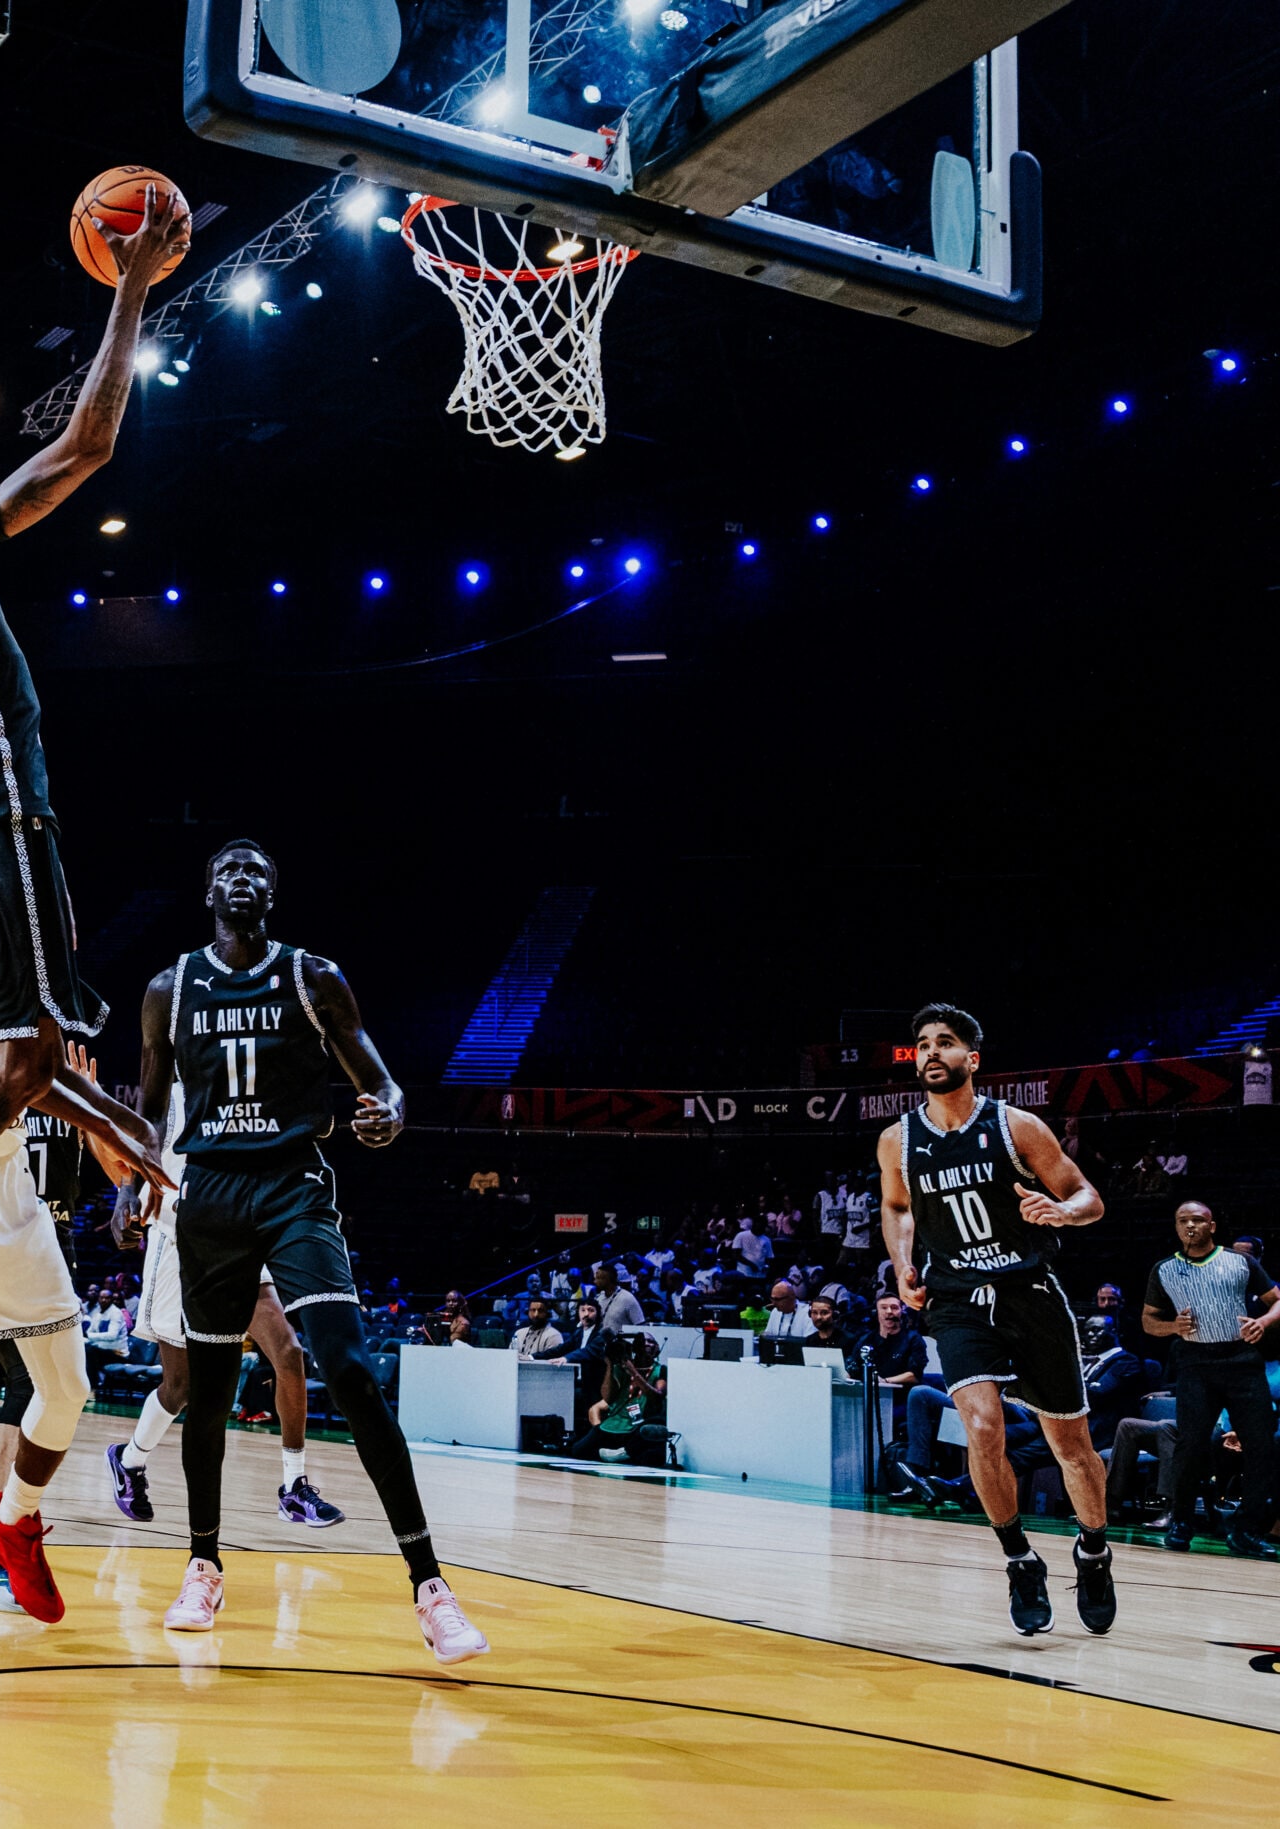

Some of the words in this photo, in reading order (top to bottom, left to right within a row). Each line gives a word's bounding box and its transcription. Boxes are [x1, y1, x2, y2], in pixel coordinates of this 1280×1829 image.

[193, 1011, 211, 1035] AL
[216, 1008, 257, 1032] AHLY
[262, 1007, 282, 1030] LY
[841, 1049, 858, 1062] 13
[895, 1048, 917, 1061] EXI
[220, 1038, 255, 1098] 11
[217, 1103, 262, 1120] VISIT
[754, 1104, 788, 1113] BLOCK
[27, 1116, 52, 1137] HLY
[56, 1118, 71, 1137] LY
[201, 1118, 280, 1136] RWANDA
[29, 1143, 47, 1195] 7
[919, 1173, 937, 1194] AL
[938, 1164, 971, 1190] AHLY
[974, 1162, 993, 1183] LY
[560, 1217, 583, 1228] EXIT
[604, 1212, 617, 1233] 3
[942, 1190, 992, 1243] 10
[960, 1242, 1001, 1261] VISIT
